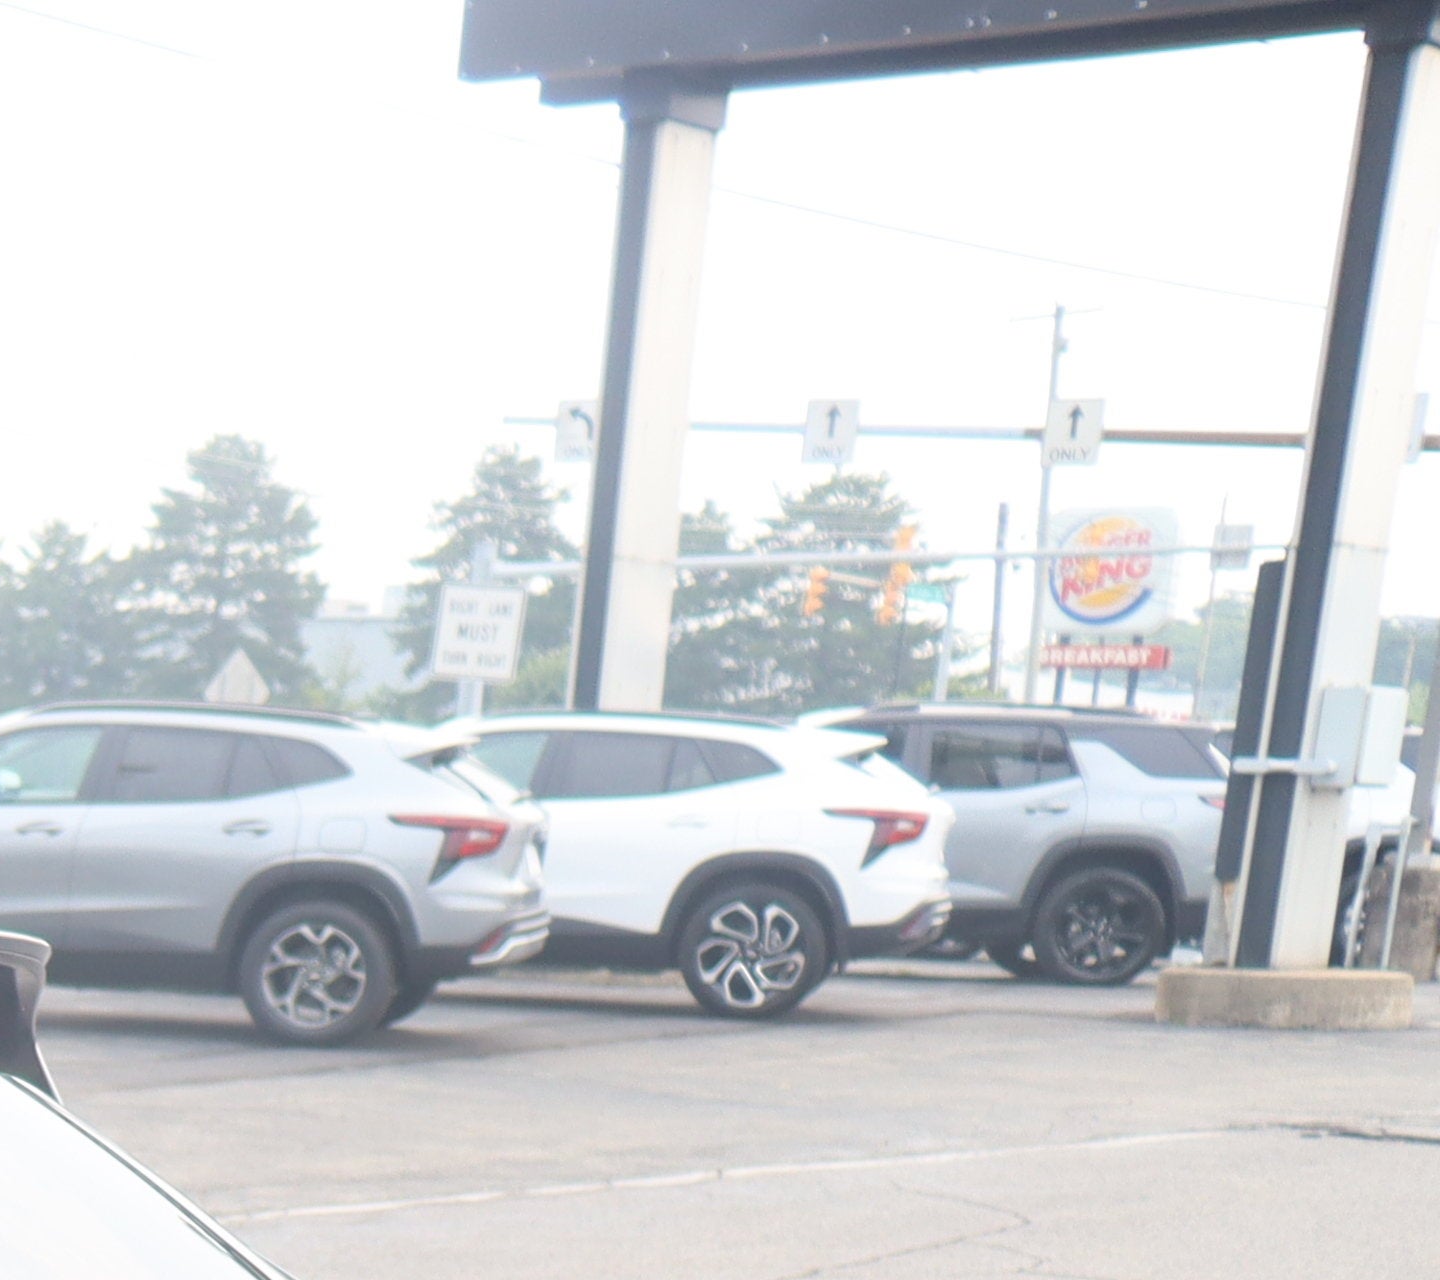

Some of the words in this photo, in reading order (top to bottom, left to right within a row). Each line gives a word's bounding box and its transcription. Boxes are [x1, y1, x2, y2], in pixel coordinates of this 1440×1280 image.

[811, 446, 844, 459] ONLY
[1050, 448, 1090, 462] ONLY
[456, 623, 498, 642] MUST
[1039, 647, 1151, 665] BREAKFAST
